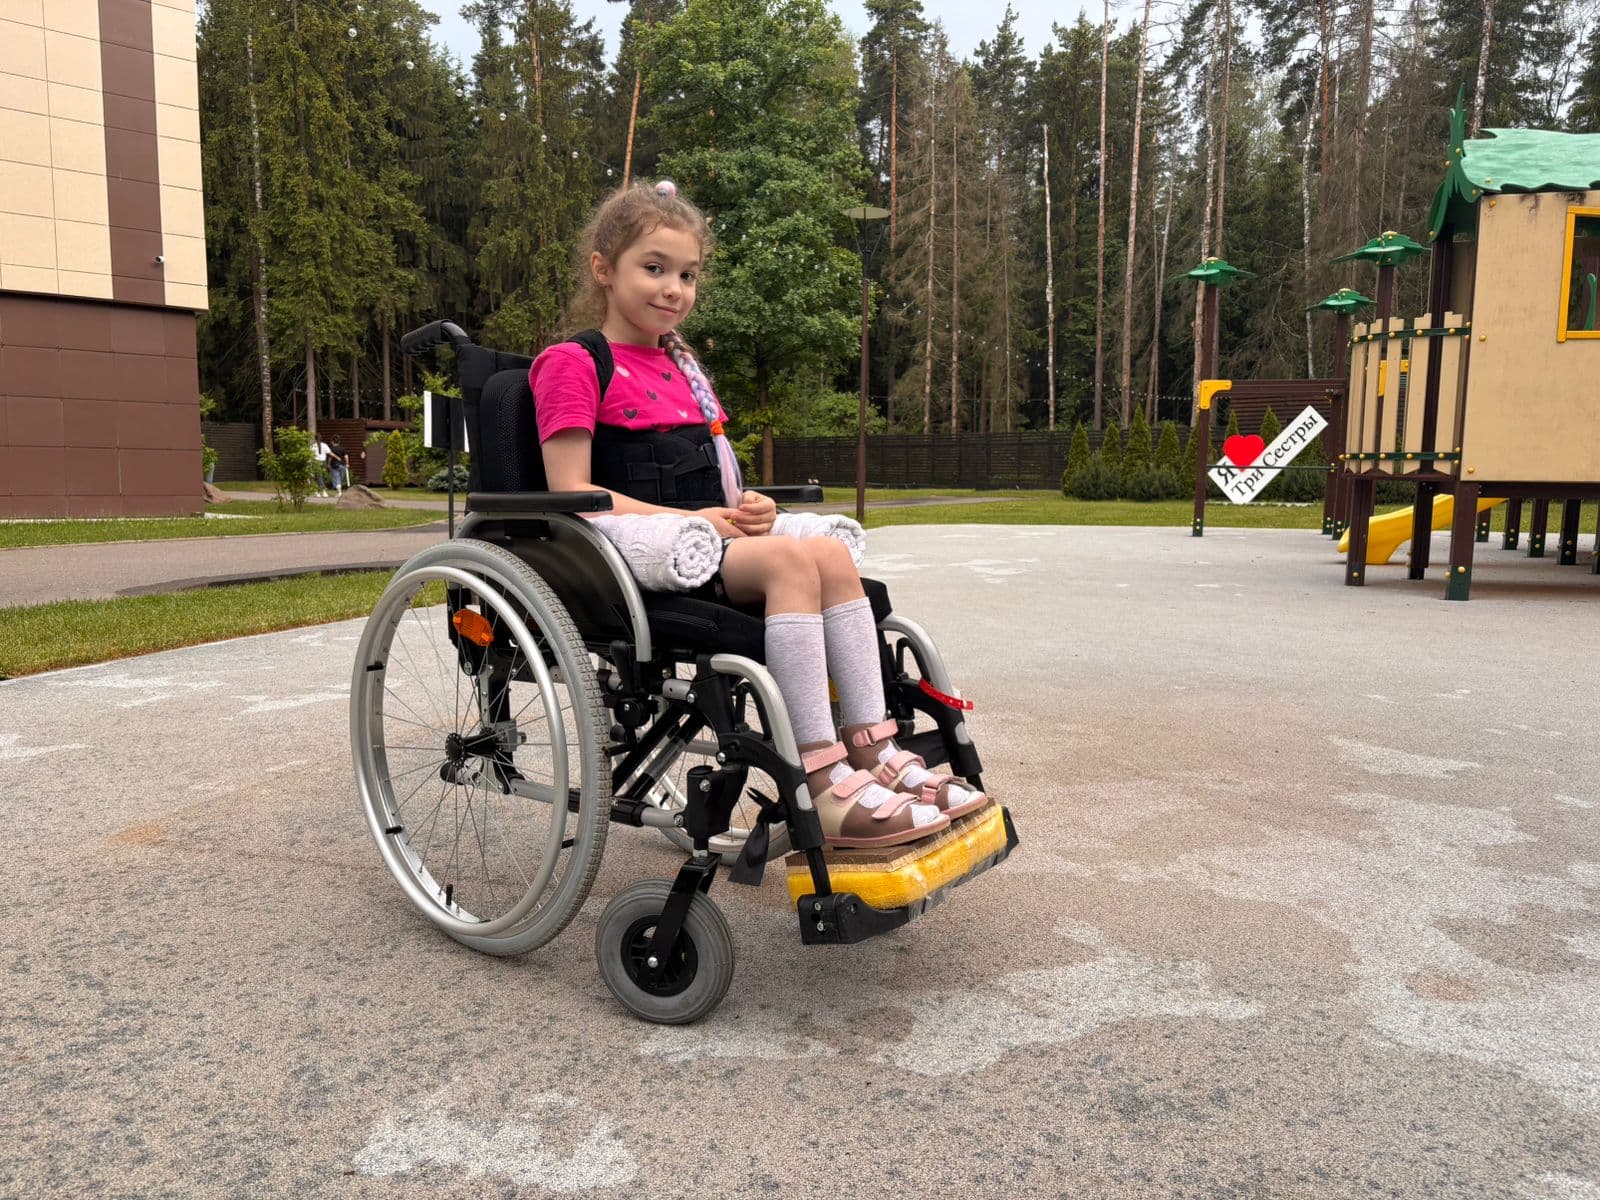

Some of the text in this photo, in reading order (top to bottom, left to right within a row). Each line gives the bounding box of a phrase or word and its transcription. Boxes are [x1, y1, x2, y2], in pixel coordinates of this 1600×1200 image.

[1217, 462, 1237, 486] Я
[1231, 415, 1319, 497] Три Сестры
